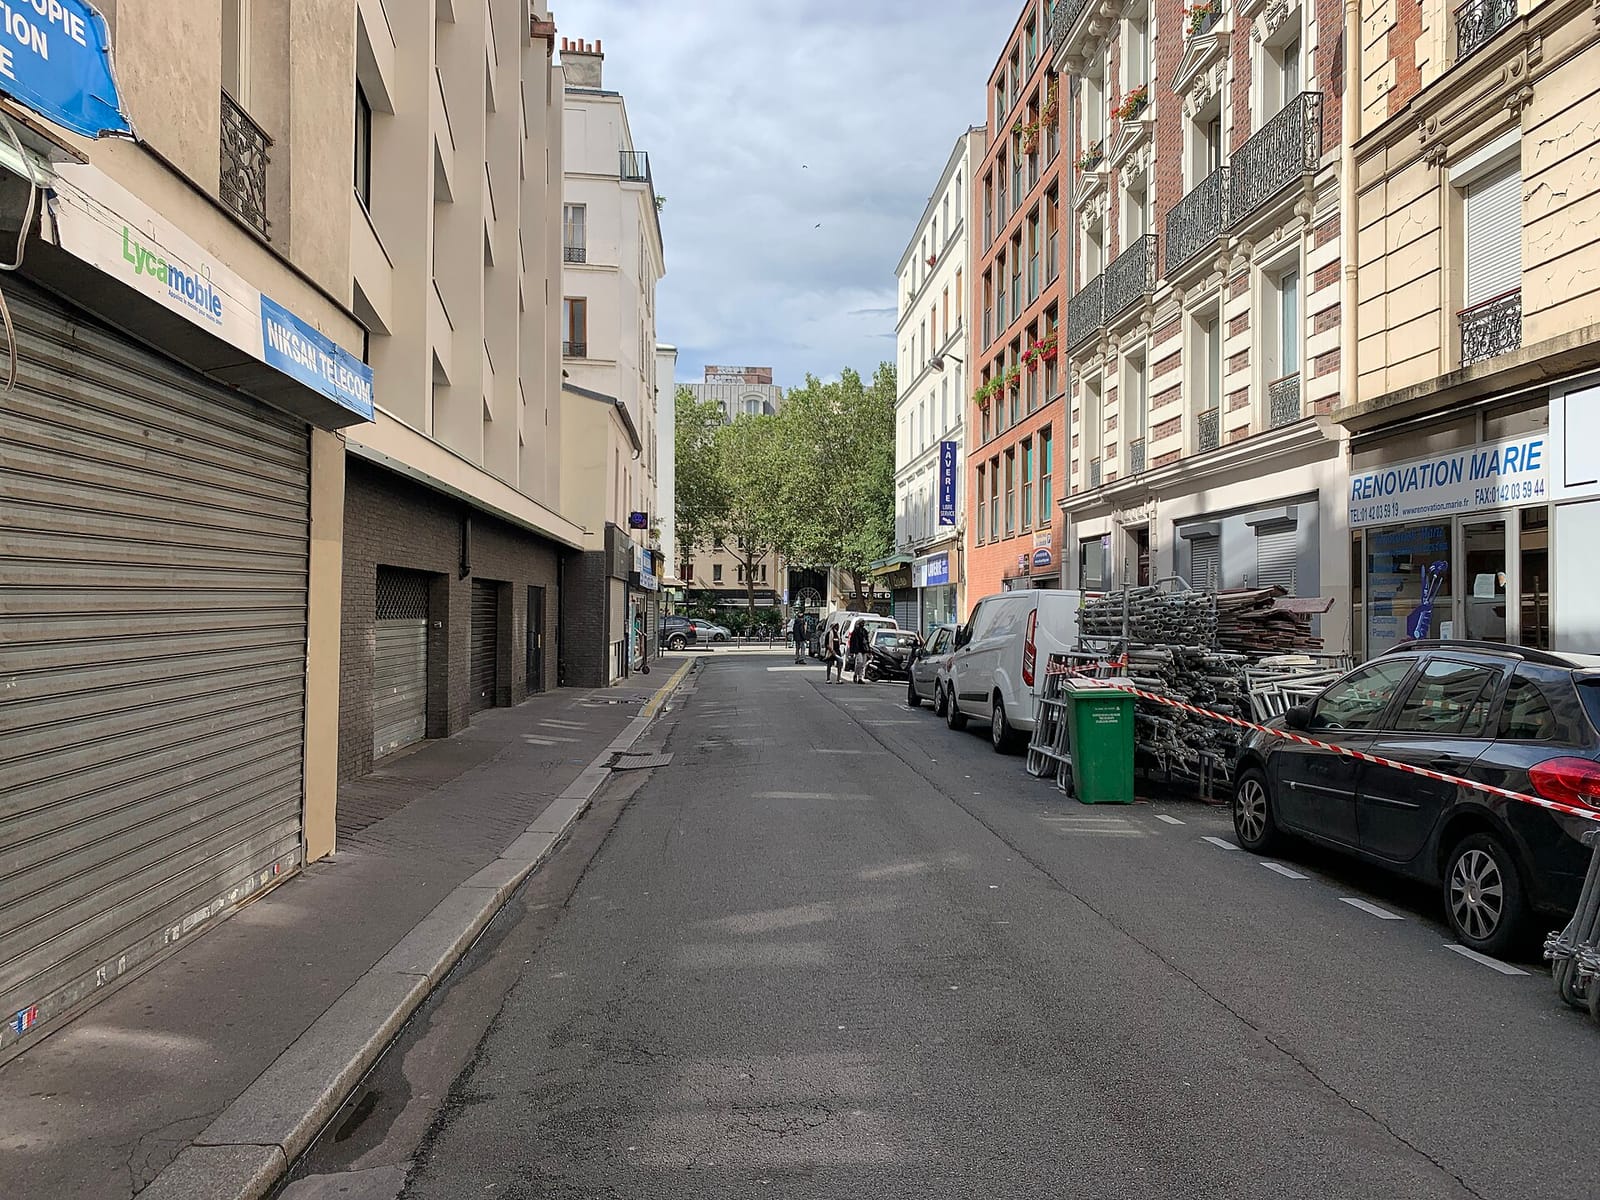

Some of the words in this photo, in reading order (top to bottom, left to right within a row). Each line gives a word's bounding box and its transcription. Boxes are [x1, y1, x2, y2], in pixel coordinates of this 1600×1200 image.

[22, 0, 87, 47] OPIE
[123, 225, 222, 317] Lycamobile
[267, 317, 318, 374] NIKSAN
[319, 352, 372, 405] TELECOM
[1352, 457, 1464, 501] RENOVATION
[1469, 440, 1543, 481] MARIE
[1511, 482, 1520, 500] 03
[1522, 480, 1532, 498] 59
[1534, 478, 1544, 496] 44
[1392, 502, 1398, 516] 19
